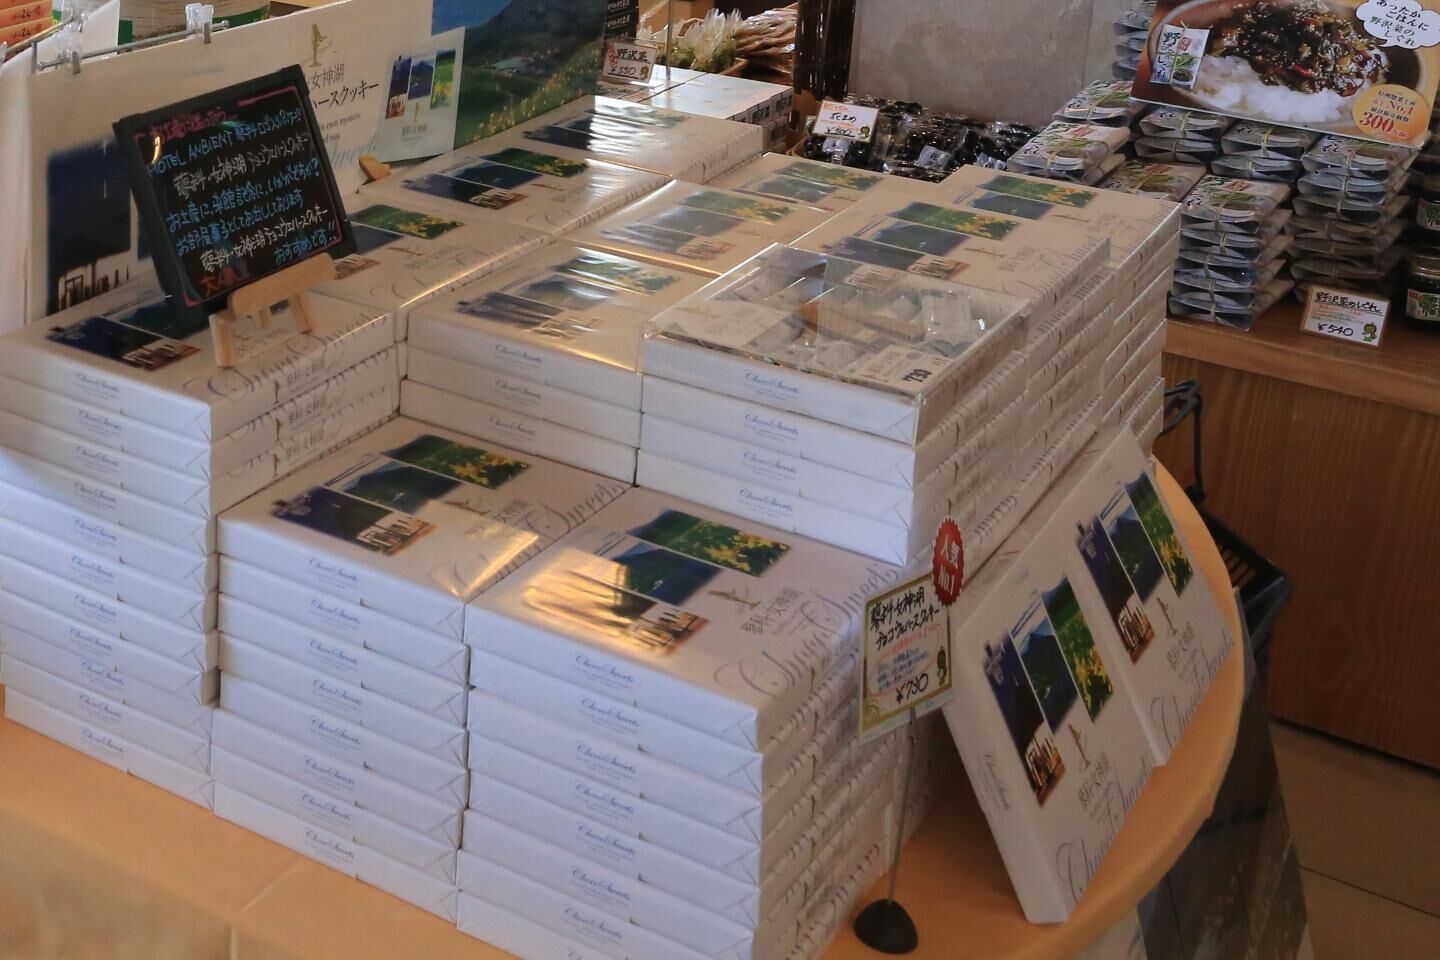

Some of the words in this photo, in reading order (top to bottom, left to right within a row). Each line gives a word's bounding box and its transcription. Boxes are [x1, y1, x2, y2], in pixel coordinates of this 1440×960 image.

[1369, 16, 1415, 37] 野沢菜の
[1386, 11, 1428, 31] ごはんに
[1385, 30, 1416, 47] しぐれ
[1389, 100, 1414, 115] No.1
[148, 154, 186, 177] HOTEL
[1314, 291, 1382, 313] 野沢菜のしぐれ
[1317, 322, 1354, 337] ¥540
[941, 535, 959, 569] 人気
[938, 566, 955, 594] No.1
[896, 673, 929, 704] ¥730
